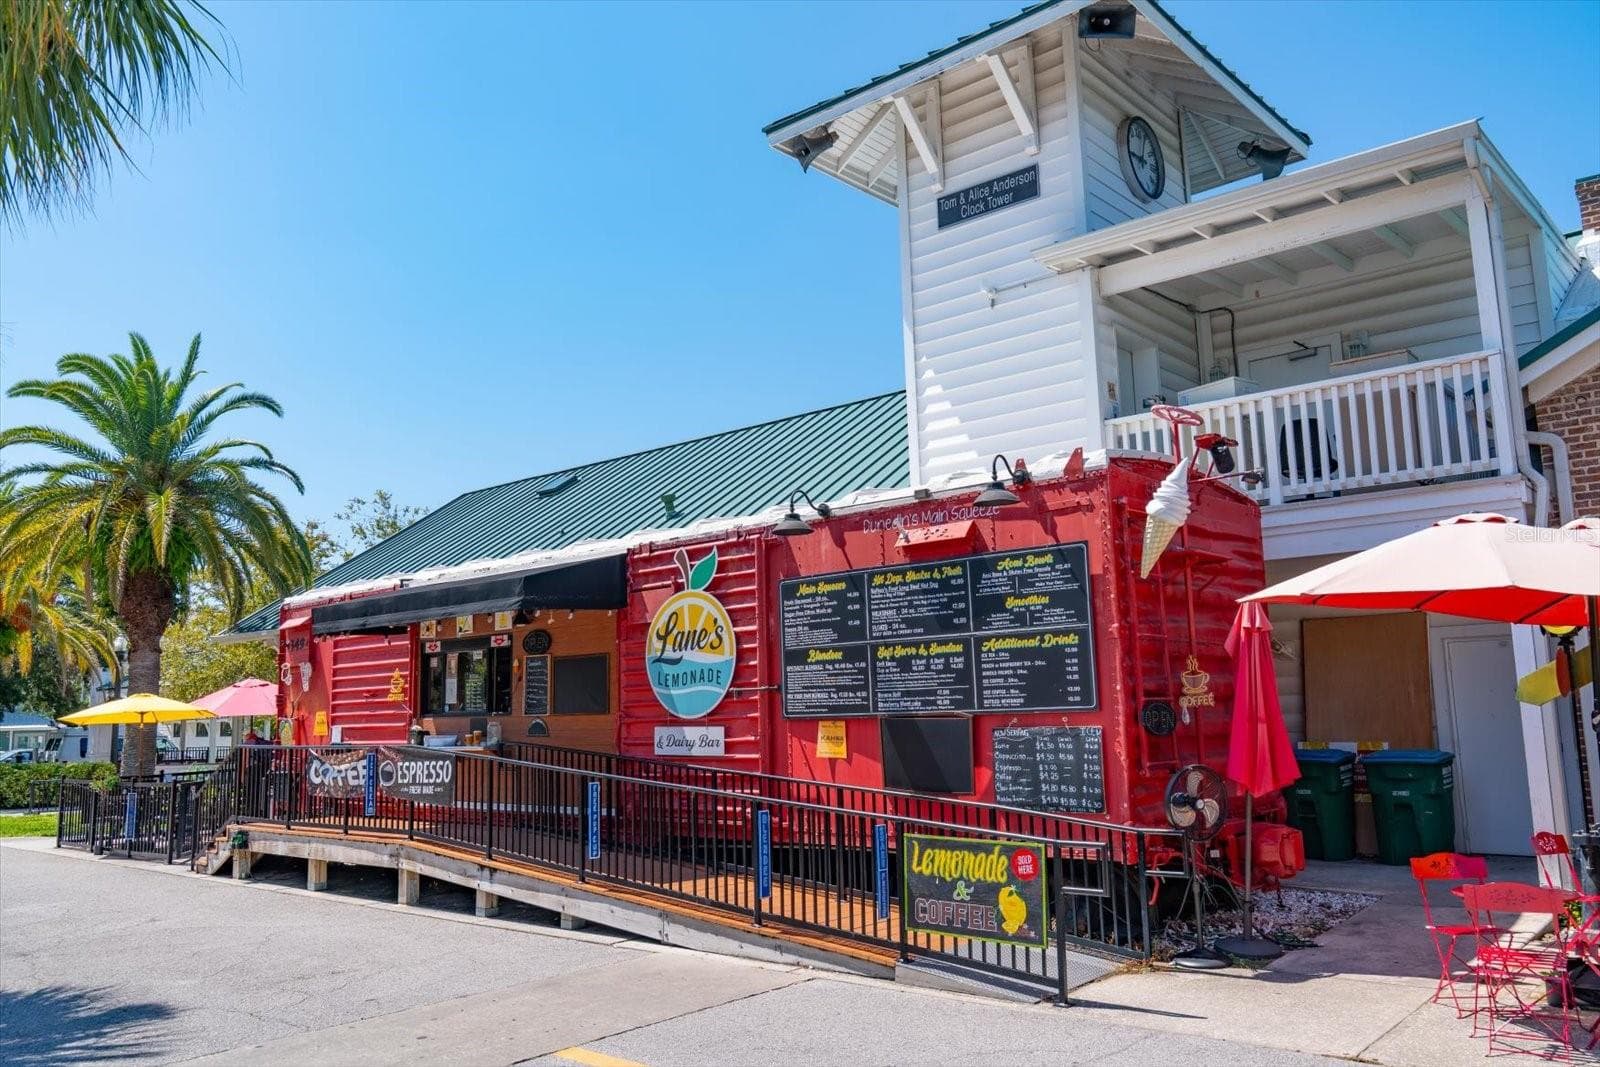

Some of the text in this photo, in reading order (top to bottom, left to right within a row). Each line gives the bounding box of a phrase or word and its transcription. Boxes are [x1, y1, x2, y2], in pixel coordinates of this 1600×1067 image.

[940, 170, 1036, 211] Tom & Alice Anderson
[960, 192, 1014, 218] Clock Tower
[863, 505, 1000, 533] Dunedin's Main Squeeze
[1005, 595, 1050, 609] Smoothies
[652, 611, 724, 665] Lane's
[981, 633, 1079, 652] Additional Drinks
[894, 645, 917, 657] Serve
[658, 668, 722, 688] LEMONADE
[656, 734, 721, 753] & Dairy Bar
[310, 759, 367, 786] COFFEE
[398, 760, 452, 783] ESPRESSO
[911, 840, 1009, 883] Lemonade
[953, 880, 974, 901] &
[914, 897, 998, 932] COFFEE
